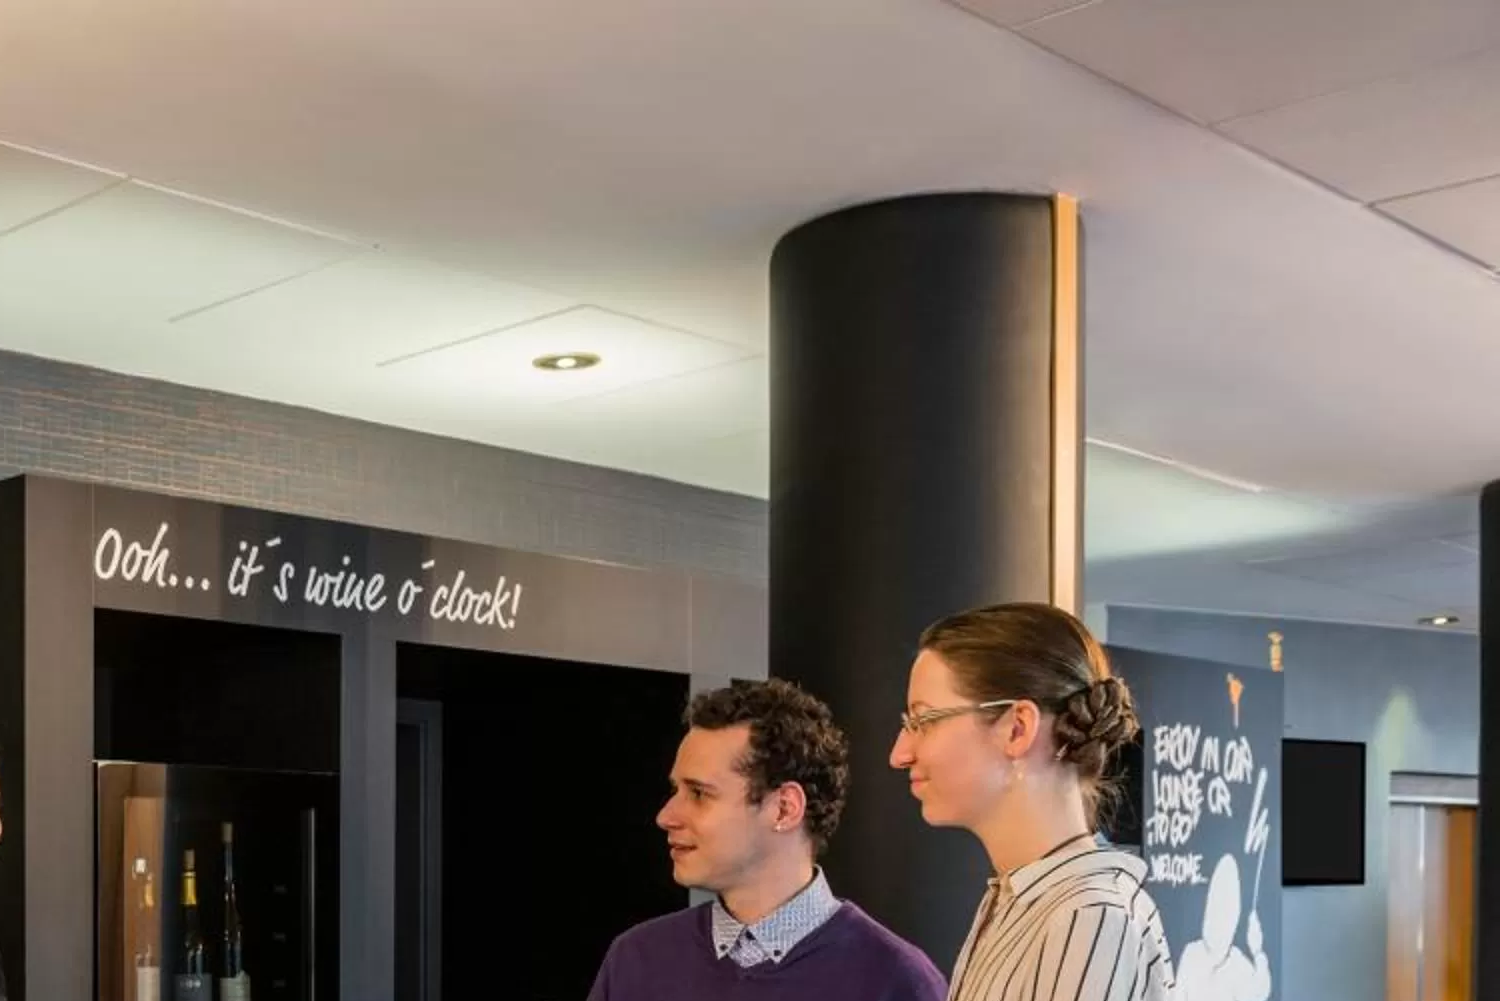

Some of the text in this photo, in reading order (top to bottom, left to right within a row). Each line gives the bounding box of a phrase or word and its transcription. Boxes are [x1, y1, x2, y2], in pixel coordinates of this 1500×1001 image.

[94, 522, 210, 591] Ooh...
[304, 555, 387, 612] wine
[1201, 736, 1220, 773] IN
[1207, 776, 1232, 817] OR
